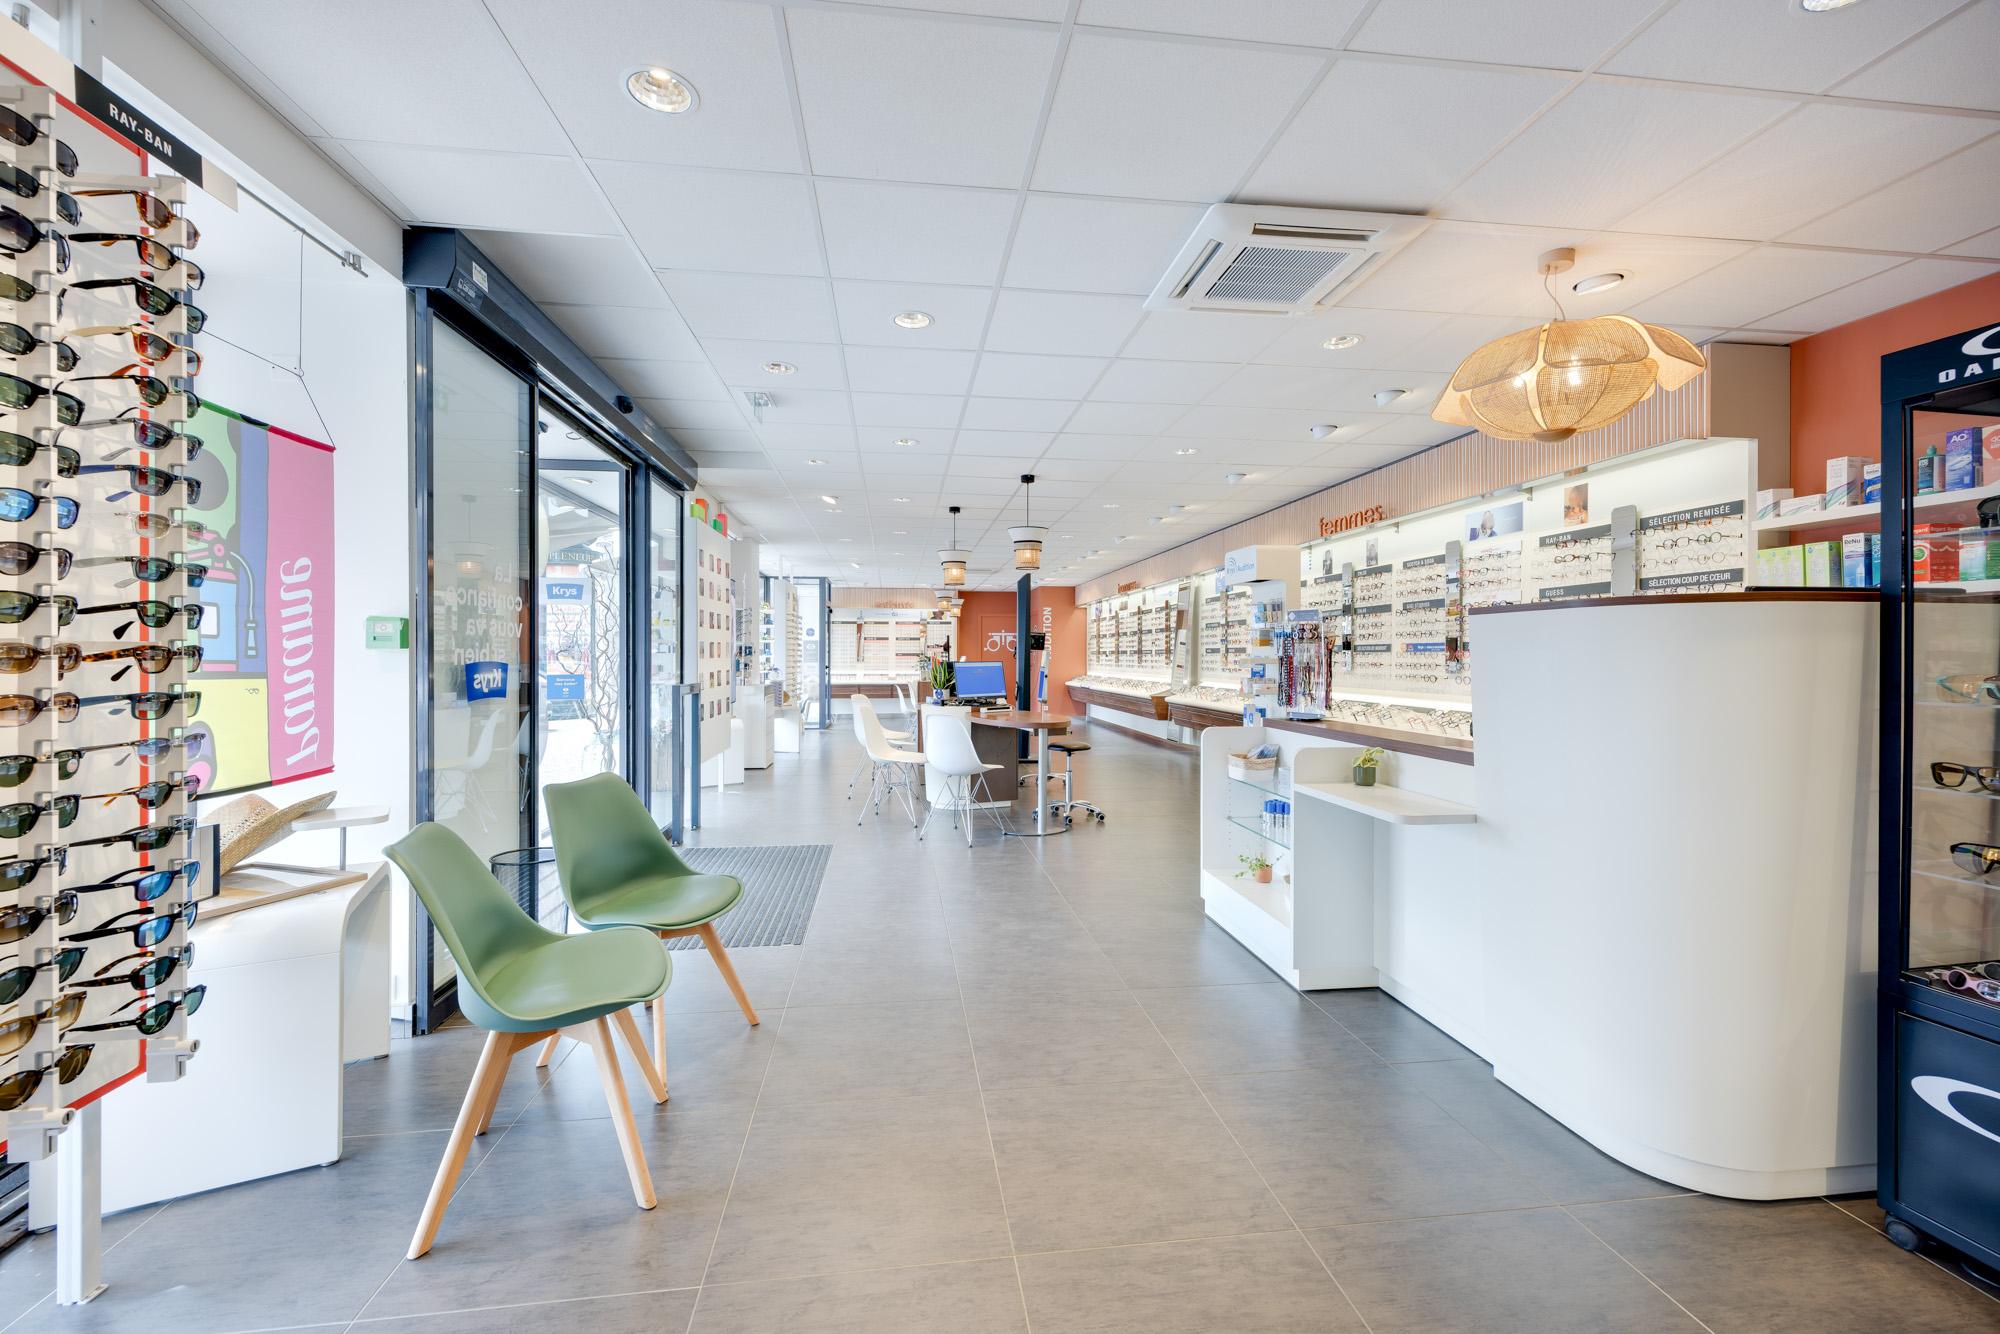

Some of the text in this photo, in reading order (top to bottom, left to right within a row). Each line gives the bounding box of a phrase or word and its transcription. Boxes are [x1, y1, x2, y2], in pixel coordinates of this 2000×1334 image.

[108, 102, 173, 158] RAY-BAN
[1319, 504, 1384, 537] femmes
[1648, 505, 1731, 526] SÉLECTION REMISÉE
[1545, 534, 1572, 544] RAY-BAN
[1648, 572, 1731, 587] SÉLECTION COUP DE CŒUR
[552, 586, 577, 596] Krys
